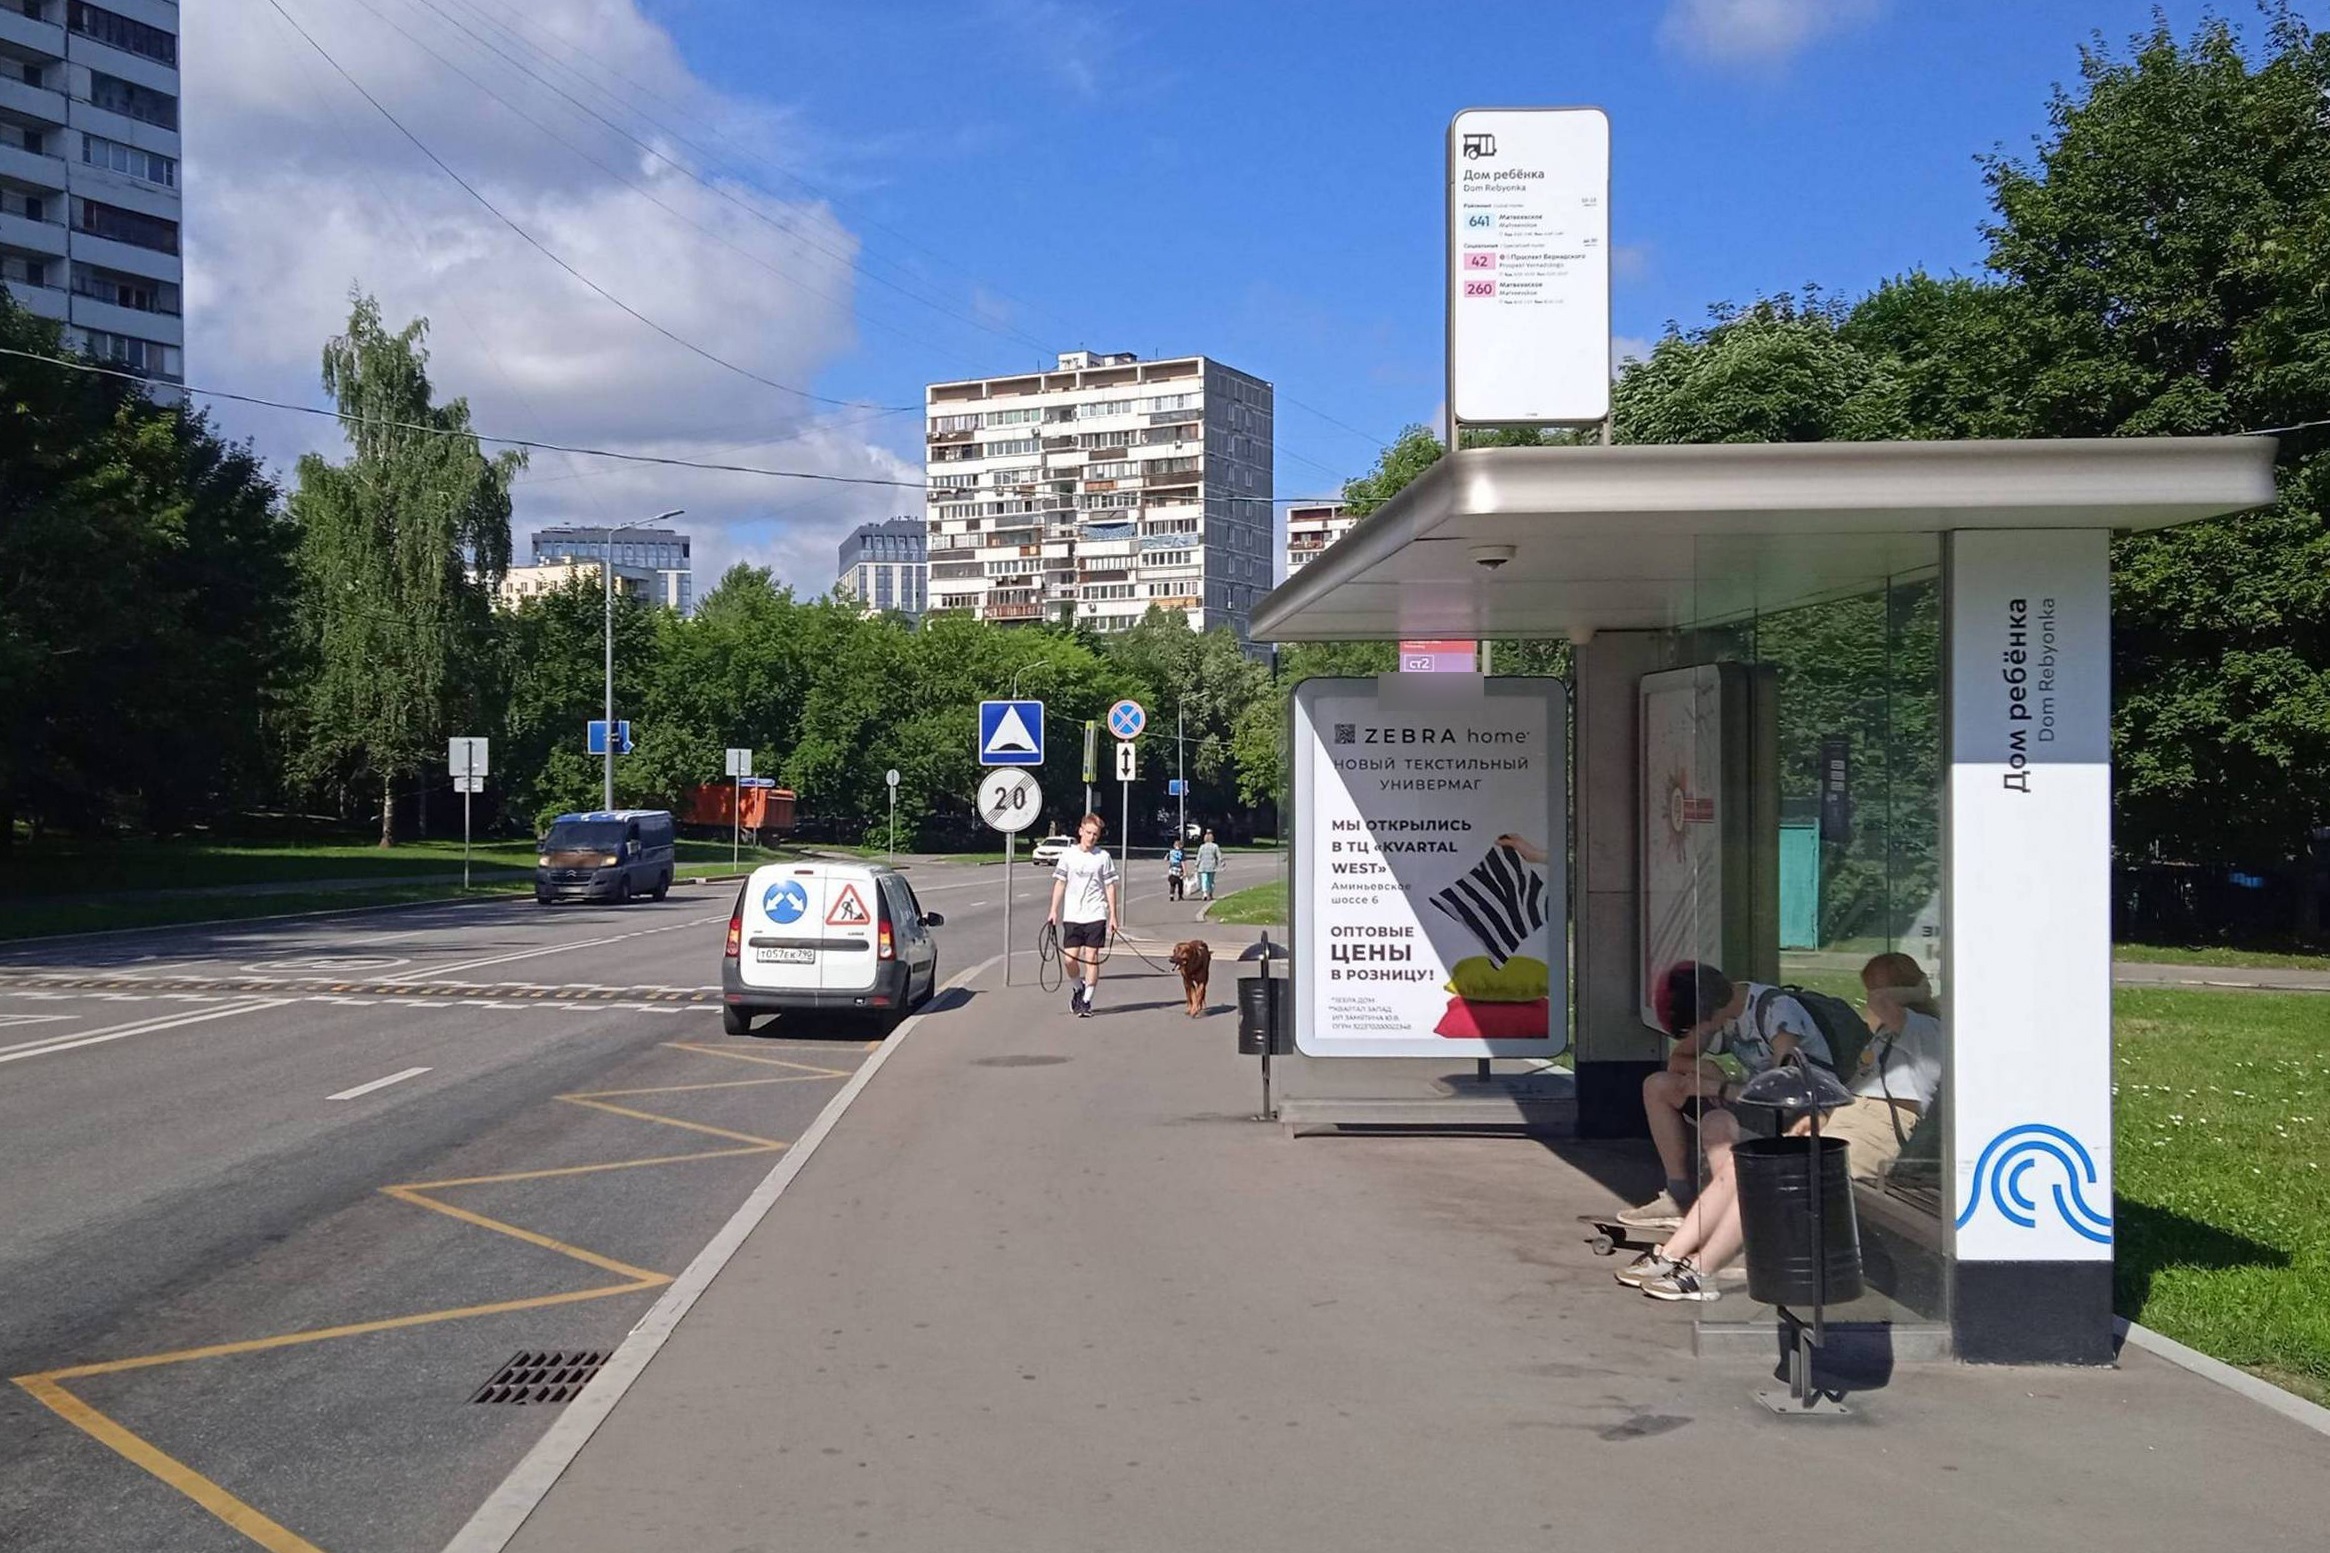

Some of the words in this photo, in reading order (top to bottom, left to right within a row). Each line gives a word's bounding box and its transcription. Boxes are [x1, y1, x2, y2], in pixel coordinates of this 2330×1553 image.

[1463, 169, 1491, 181] Дом
[1494, 168, 1545, 181] ребёнка
[1463, 184, 1483, 192] Dom
[1485, 183, 1526, 192] Rebyonka
[1469, 215, 1490, 227] 641
[1472, 255, 1488, 267] 42
[1467, 283, 1493, 295] 260
[2037, 598, 2059, 692] Rebyonka
[2003, 598, 2032, 721] ребёнка
[2038, 698, 2055, 742] Dom
[1364, 728, 1456, 744] ZEBRA
[1334, 757, 1396, 770] НОВЫЙ
[1404, 757, 1529, 770] ТЕКСТИЛЬНЫЙ
[2003, 729, 2031, 793] Дом
[1379, 779, 1482, 791] УНИВЕРМАГ
[994, 786, 1026, 811] 20
[1332, 820, 1361, 831] МЫ
[1366, 819, 1472, 831] ОТКРЫЛИСЬ
[1331, 841, 1342, 852] В
[1346, 841, 1369, 854] ТЦ
[1374, 841, 1458, 853] «KVARTAL
[1331, 882, 1412, 891] Аминьевское
[1331, 896, 1369, 904] шоссе
[1371, 895, 1379, 904] 6
[1330, 926, 1415, 937] ОПТОВЫЕ
[1331, 944, 1411, 964] ЦЕНЫ
[1331, 969, 1341, 980] В
[1346, 969, 1434, 982] РОЗНИЦУ!
